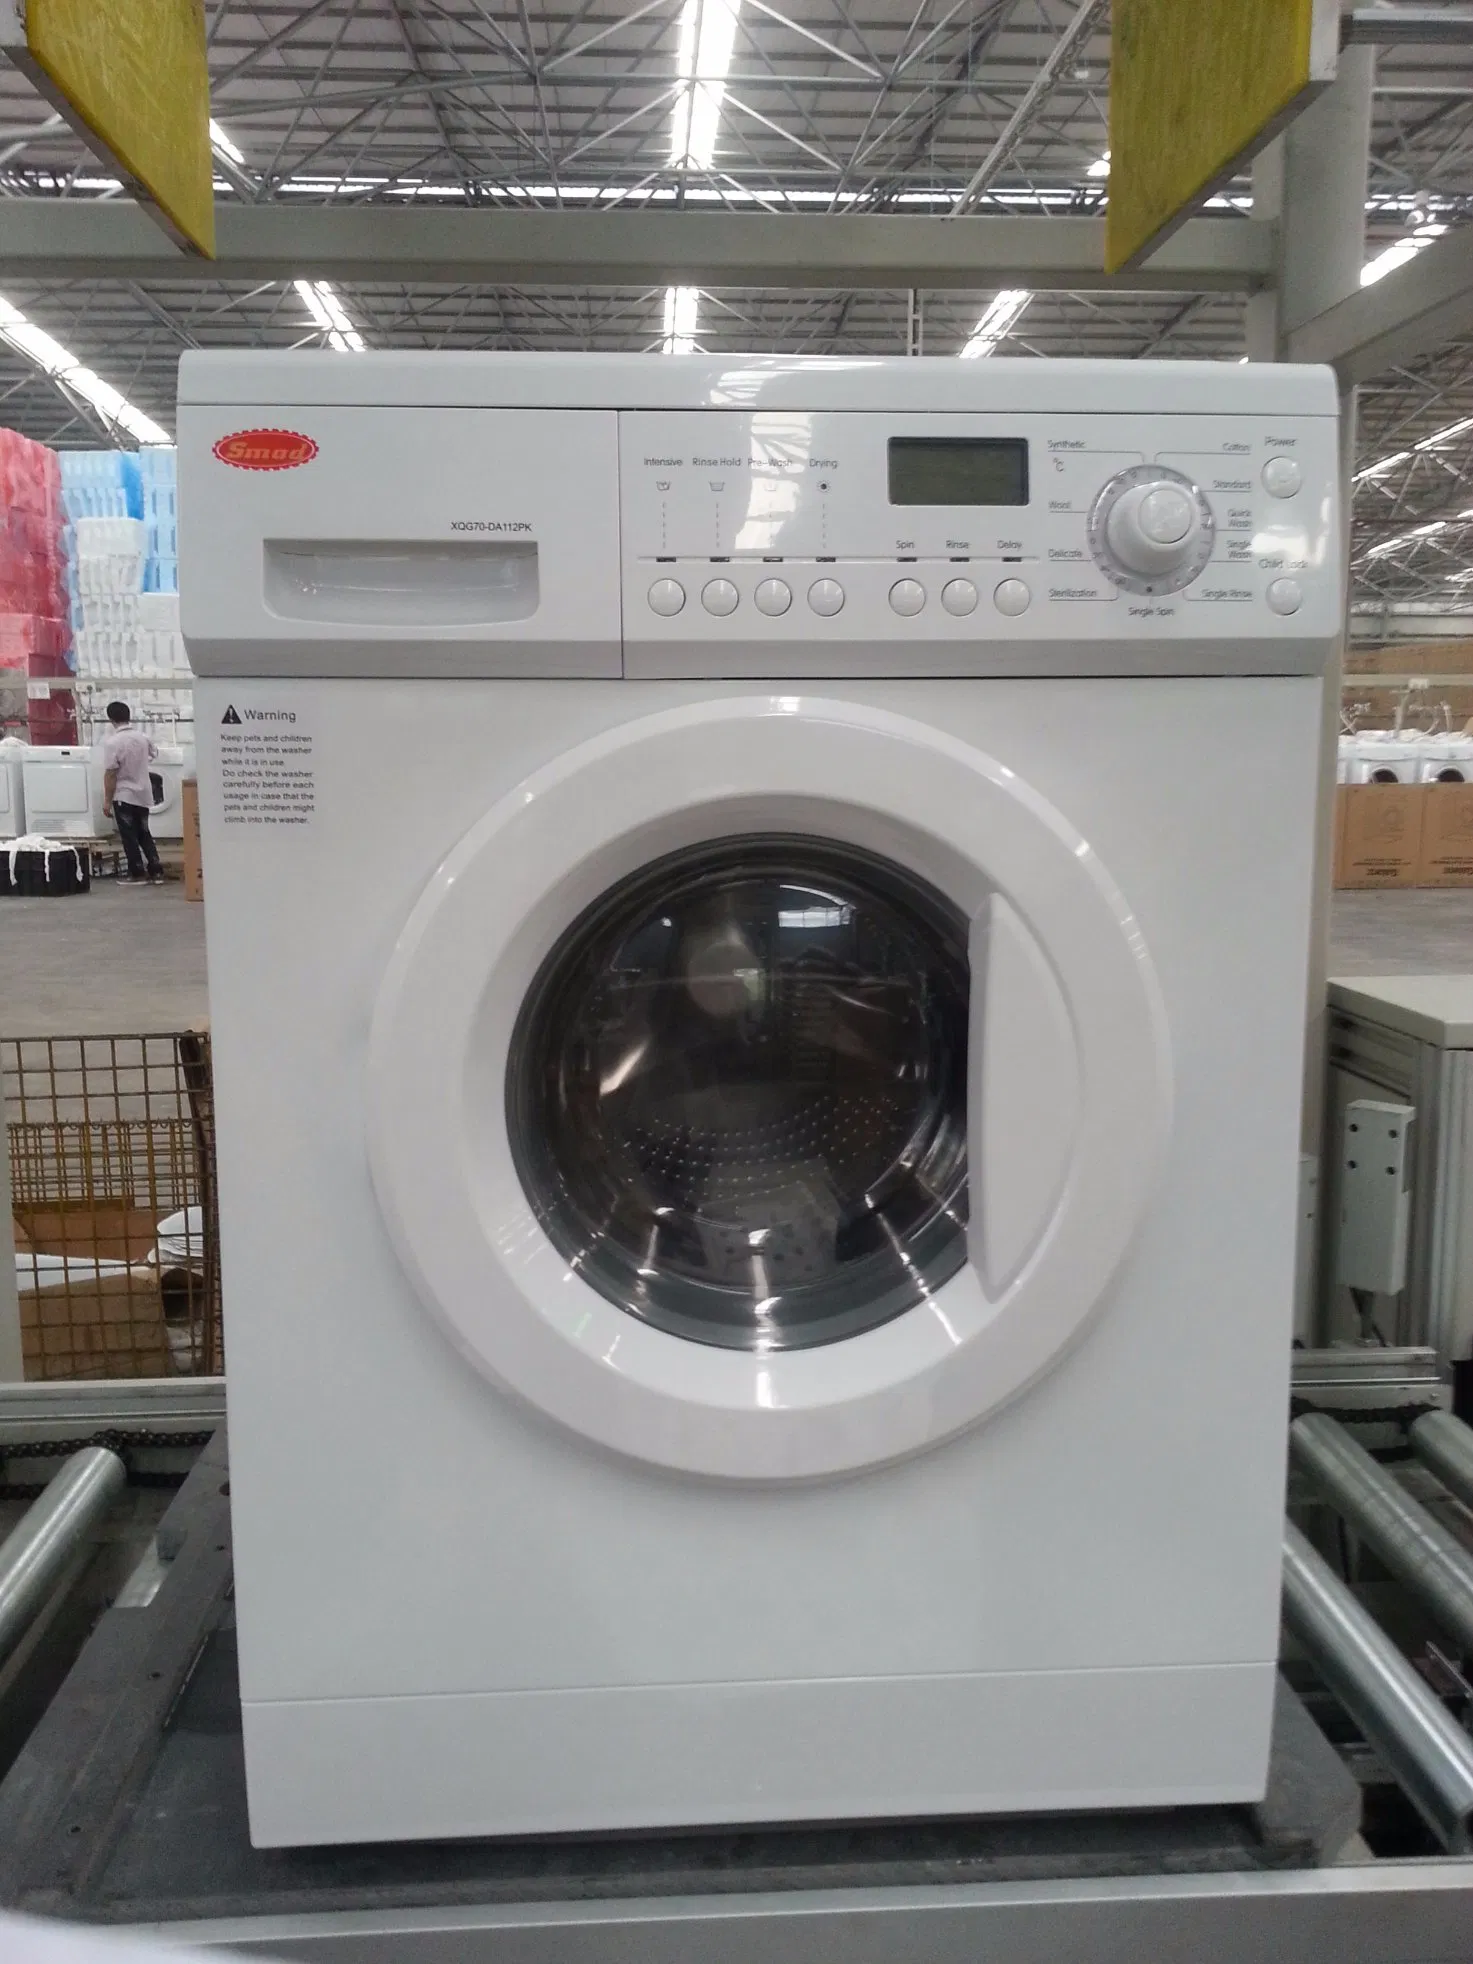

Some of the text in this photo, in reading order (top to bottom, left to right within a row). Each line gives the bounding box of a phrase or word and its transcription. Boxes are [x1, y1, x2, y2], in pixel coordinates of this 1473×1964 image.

[1047, 440, 1086, 450] Synthetic
[1264, 436, 1297, 446] Power
[227, 441, 308, 460] Smad
[1222, 442, 1251, 452] Cotton
[644, 458, 683, 467] Intensive
[692, 458, 742, 467] Rinse Hold
[748, 458, 793, 467] Pre-Wash
[809, 458, 838, 469] Drying
[1212, 480, 1251, 489] Standard
[1048, 500, 1071, 509] Wool
[450, 522, 532, 532] XQG70-DA112PK
[1228, 520, 1252, 528] Wash
[896, 540, 915, 551] Spin
[946, 540, 970, 549] Rinse
[997, 540, 1022, 551] Delay
[1048, 549, 1082, 558] Delicate
[1228, 551, 1252, 559] Wash
[1259, 559, 1283, 569] Child
[1048, 588, 1097, 598] Sterilization
[1200, 589, 1253, 600] Single Rinse
[1128, 607, 1175, 618] Single Spin
[244, 709, 296, 723] Warning
[221, 734, 242, 743] Keep
[244, 735, 261, 743] pets
[280, 734, 312, 742] children
[221, 747, 242, 755] away
[281, 746, 312, 754] washer
[221, 758, 242, 766] while
[222, 769, 312, 778] Do check the washer
[222, 781, 314, 790] carefully before each
[223, 793, 249, 801] usage
[283, 792, 299, 800] that
[223, 804, 241, 812] pets
[259, 804, 291, 812] children
[293, 804, 315, 813] might
